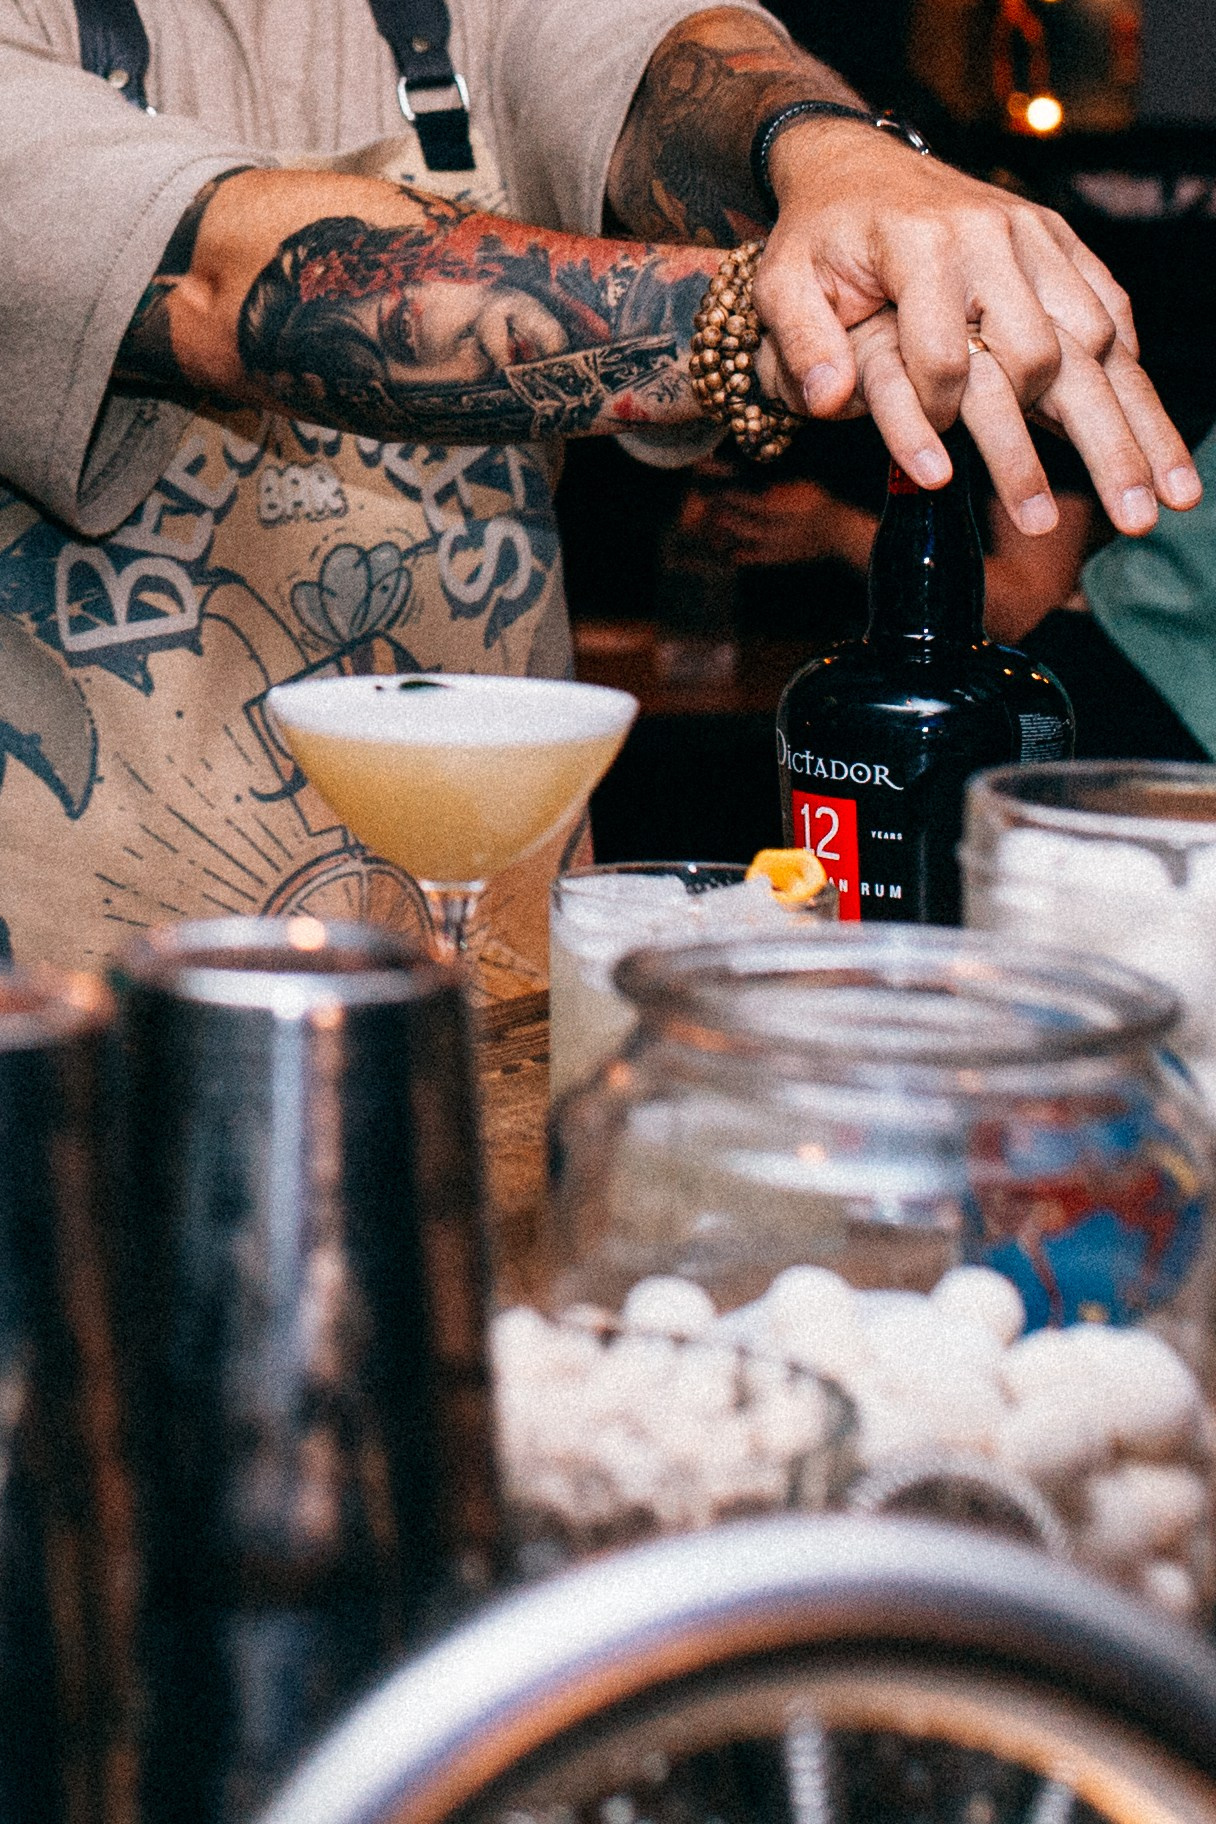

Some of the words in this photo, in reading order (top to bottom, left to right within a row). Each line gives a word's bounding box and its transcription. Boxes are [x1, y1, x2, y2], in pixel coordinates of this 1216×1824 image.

[801, 803, 840, 861] 12
[871, 830, 903, 841] YEARS
[861, 882, 902, 899] RUM
